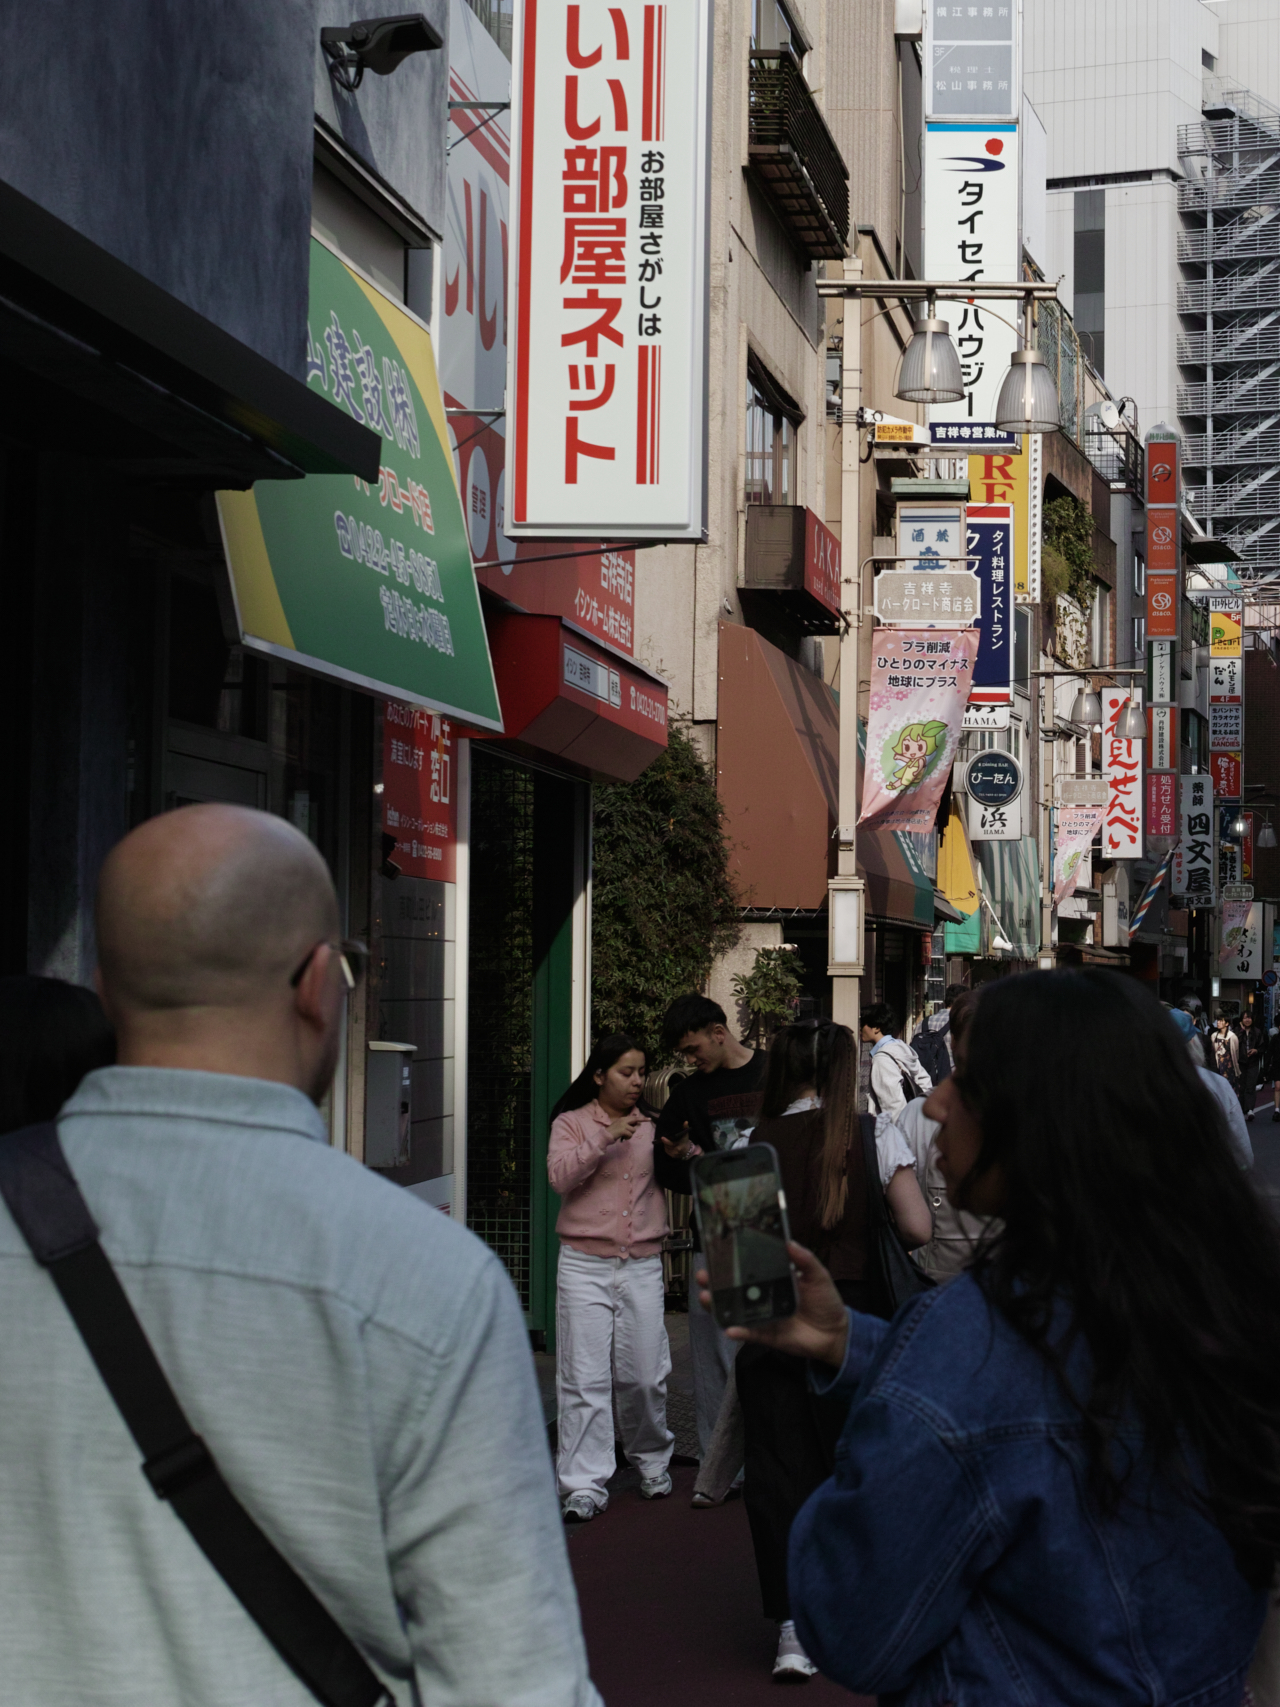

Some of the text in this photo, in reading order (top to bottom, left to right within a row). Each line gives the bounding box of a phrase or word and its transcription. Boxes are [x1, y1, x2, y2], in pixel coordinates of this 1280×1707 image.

[934, 47, 945, 56] 3F
[949, 66, 995, 74] 税理士
[936, 80, 1009, 91] 松山事務所
[560, 4, 630, 485] いい部屋ネット
[638, 150, 665, 337] お部屋さがしは
[935, 426, 1007, 439] 吉祥寺営業所
[601, 546, 633, 606] 吉祥寺店
[903, 582, 953, 593] 吉祥寺
[991, 530, 1005, 650] タイ料理レストラン
[881, 598, 973, 612] パークロード商店会
[1212, 598, 1240, 609] 中外ビル
[574, 586, 633, 648] イシンホーム株式会社
[1231, 613, 1241, 621] 5F
[901, 640, 951, 654] プラ削減
[877, 657, 969, 670] ひとりのマイナス
[887, 674, 958, 688] 地球にプラス
[1227, 661, 1236, 694] ホルモン屋
[1160, 775, 1171, 834] 処方せん受付
[980, 807, 1008, 829] 浜
[1186, 813, 1212, 892] 四文屋
